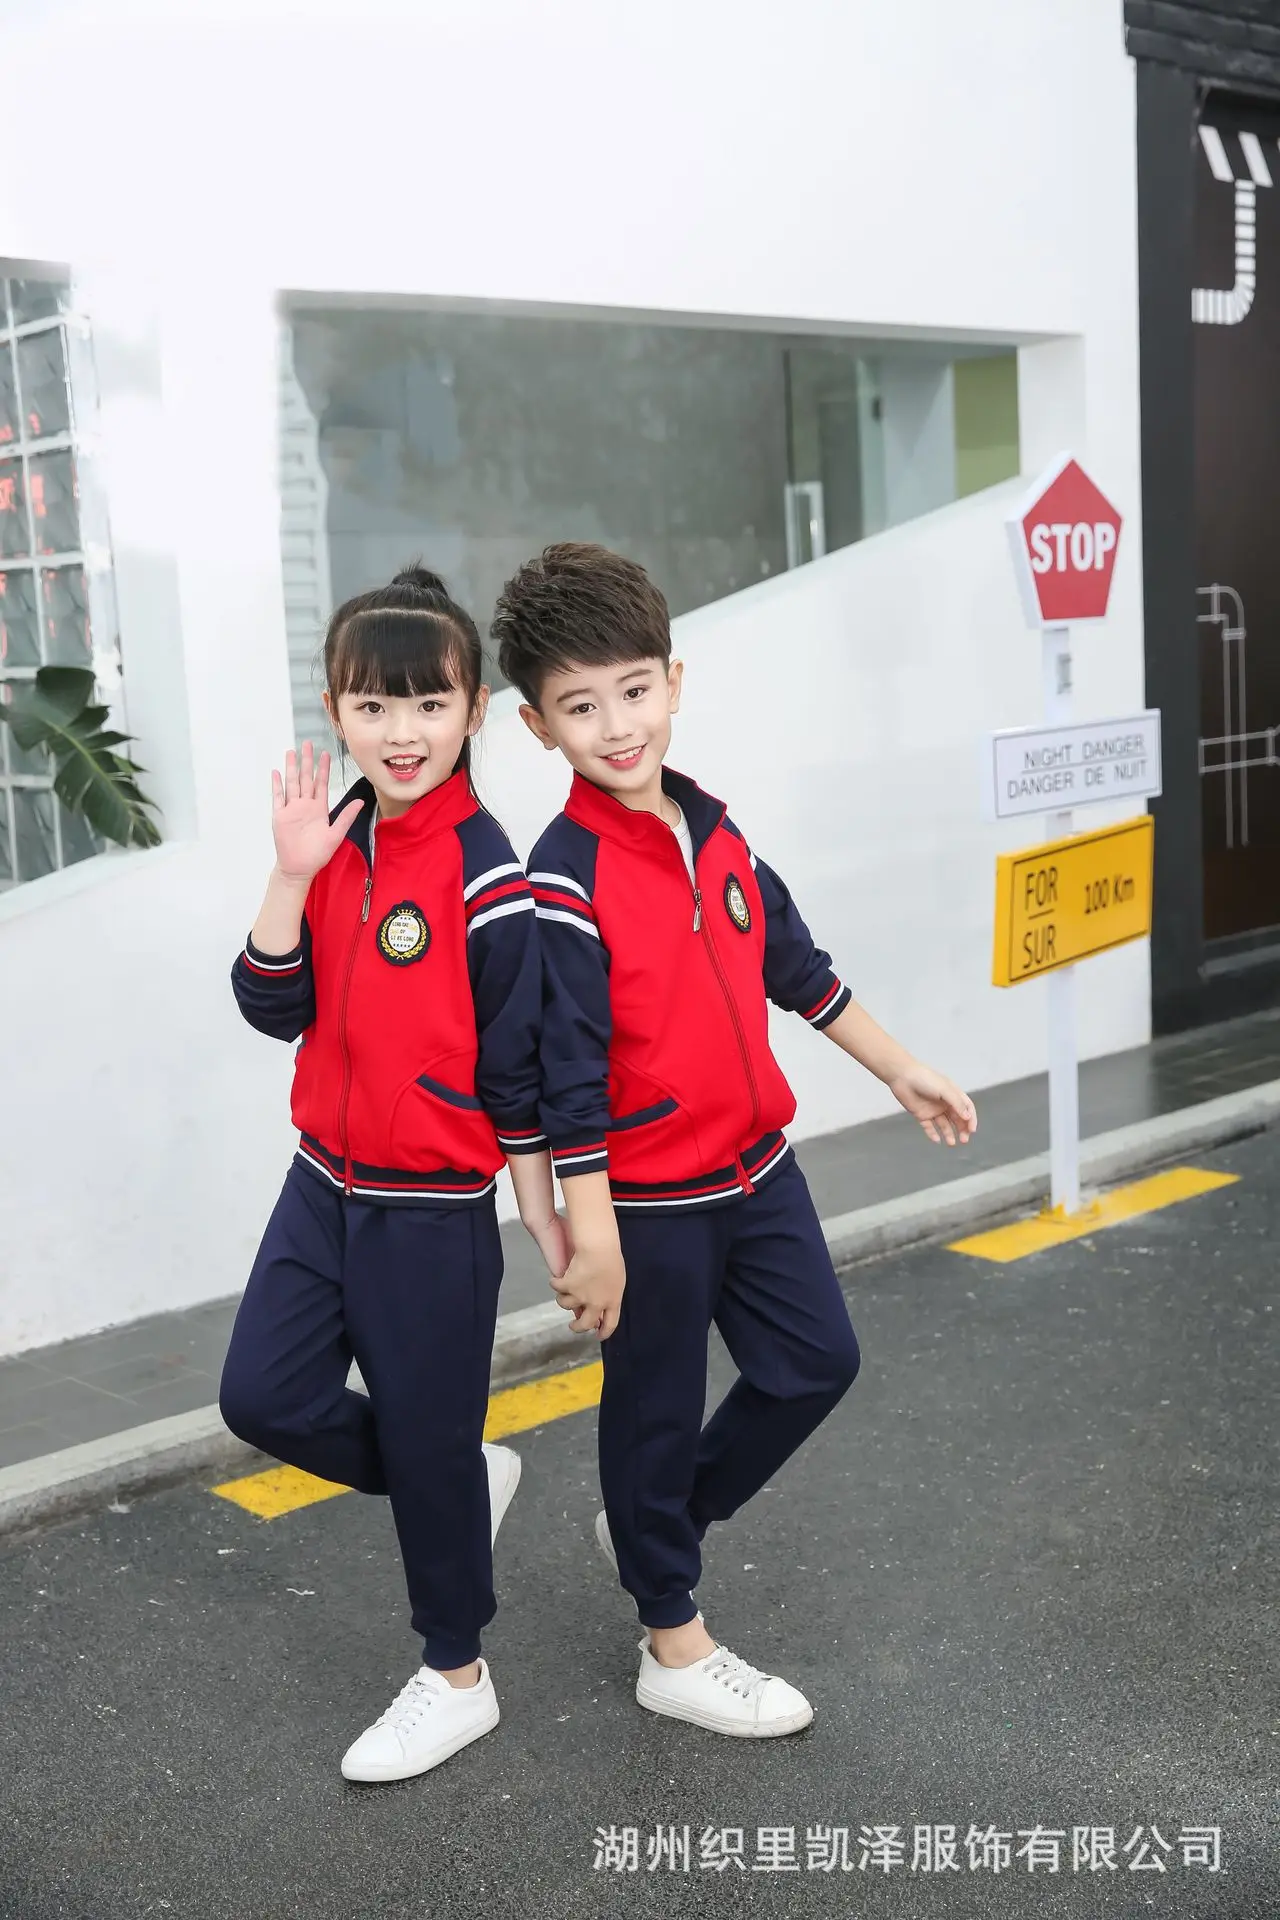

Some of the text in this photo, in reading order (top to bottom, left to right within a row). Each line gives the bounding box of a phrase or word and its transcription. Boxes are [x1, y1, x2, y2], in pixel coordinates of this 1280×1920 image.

[1031, 522, 1116, 574] STOP
[1024, 733, 1145, 769] NIGHT DANGER
[1007, 760, 1147, 799] DANGER DE NUIT
[1025, 866, 1058, 911] FOR
[1084, 874, 1135, 915] 100 Km
[1023, 924, 1056, 969] SUR
